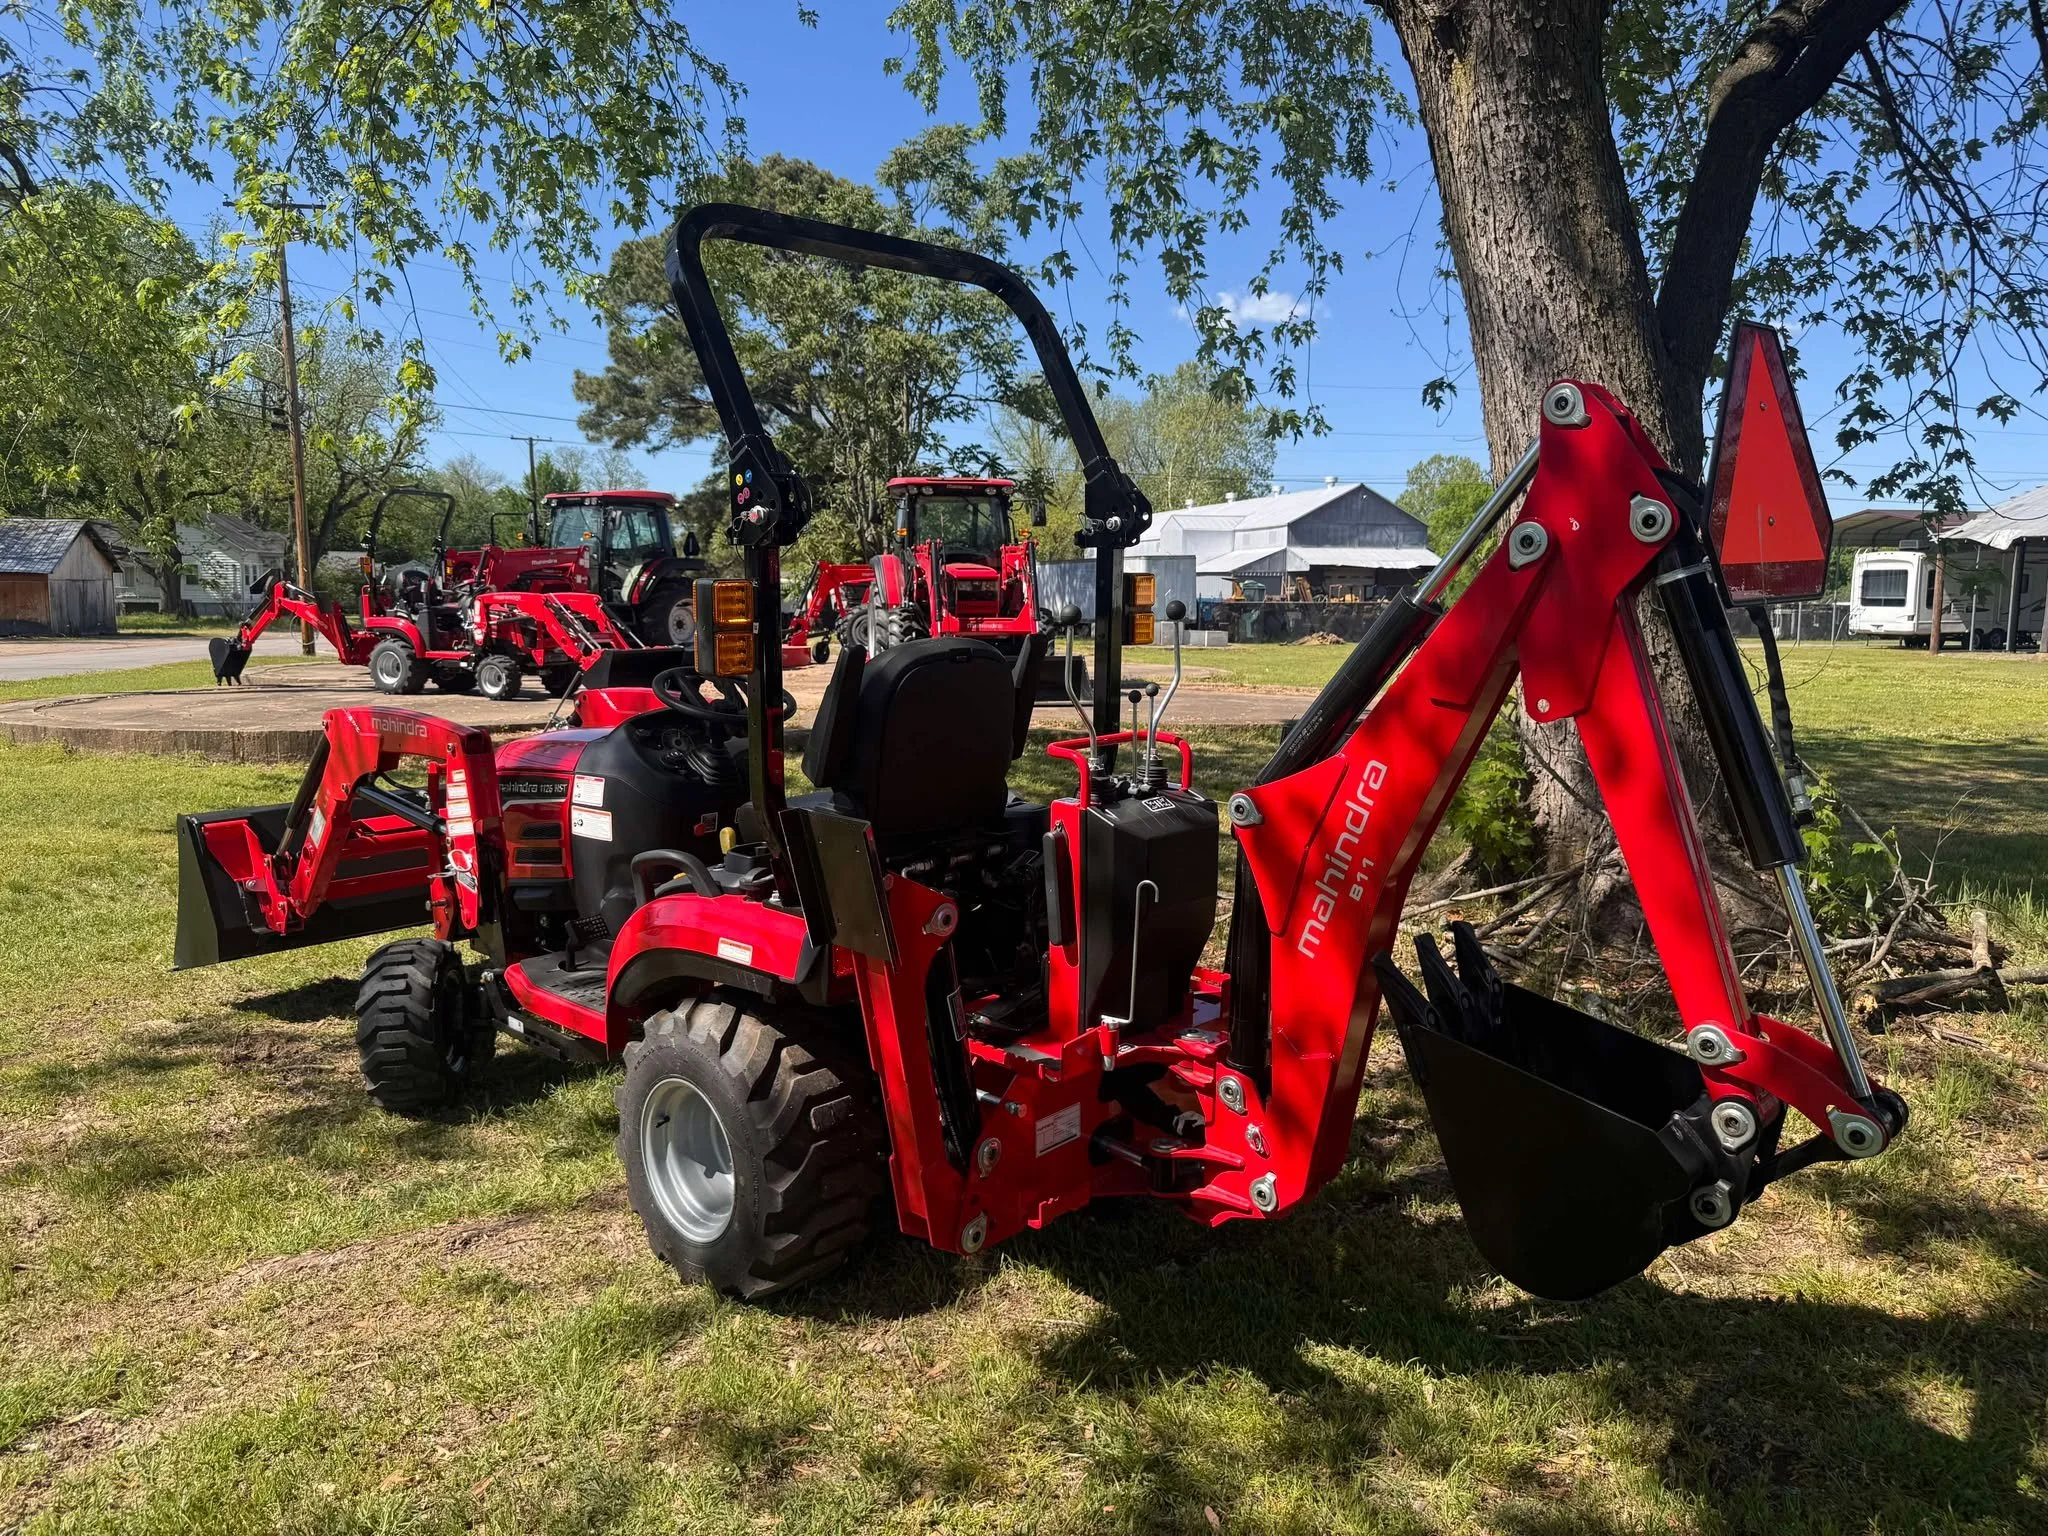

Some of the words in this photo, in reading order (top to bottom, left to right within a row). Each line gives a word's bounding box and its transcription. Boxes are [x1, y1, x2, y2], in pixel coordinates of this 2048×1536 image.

[371, 716, 428, 738] mahindra
[1297, 759, 1388, 960] mahindra
[1348, 857, 1375, 902] B11
